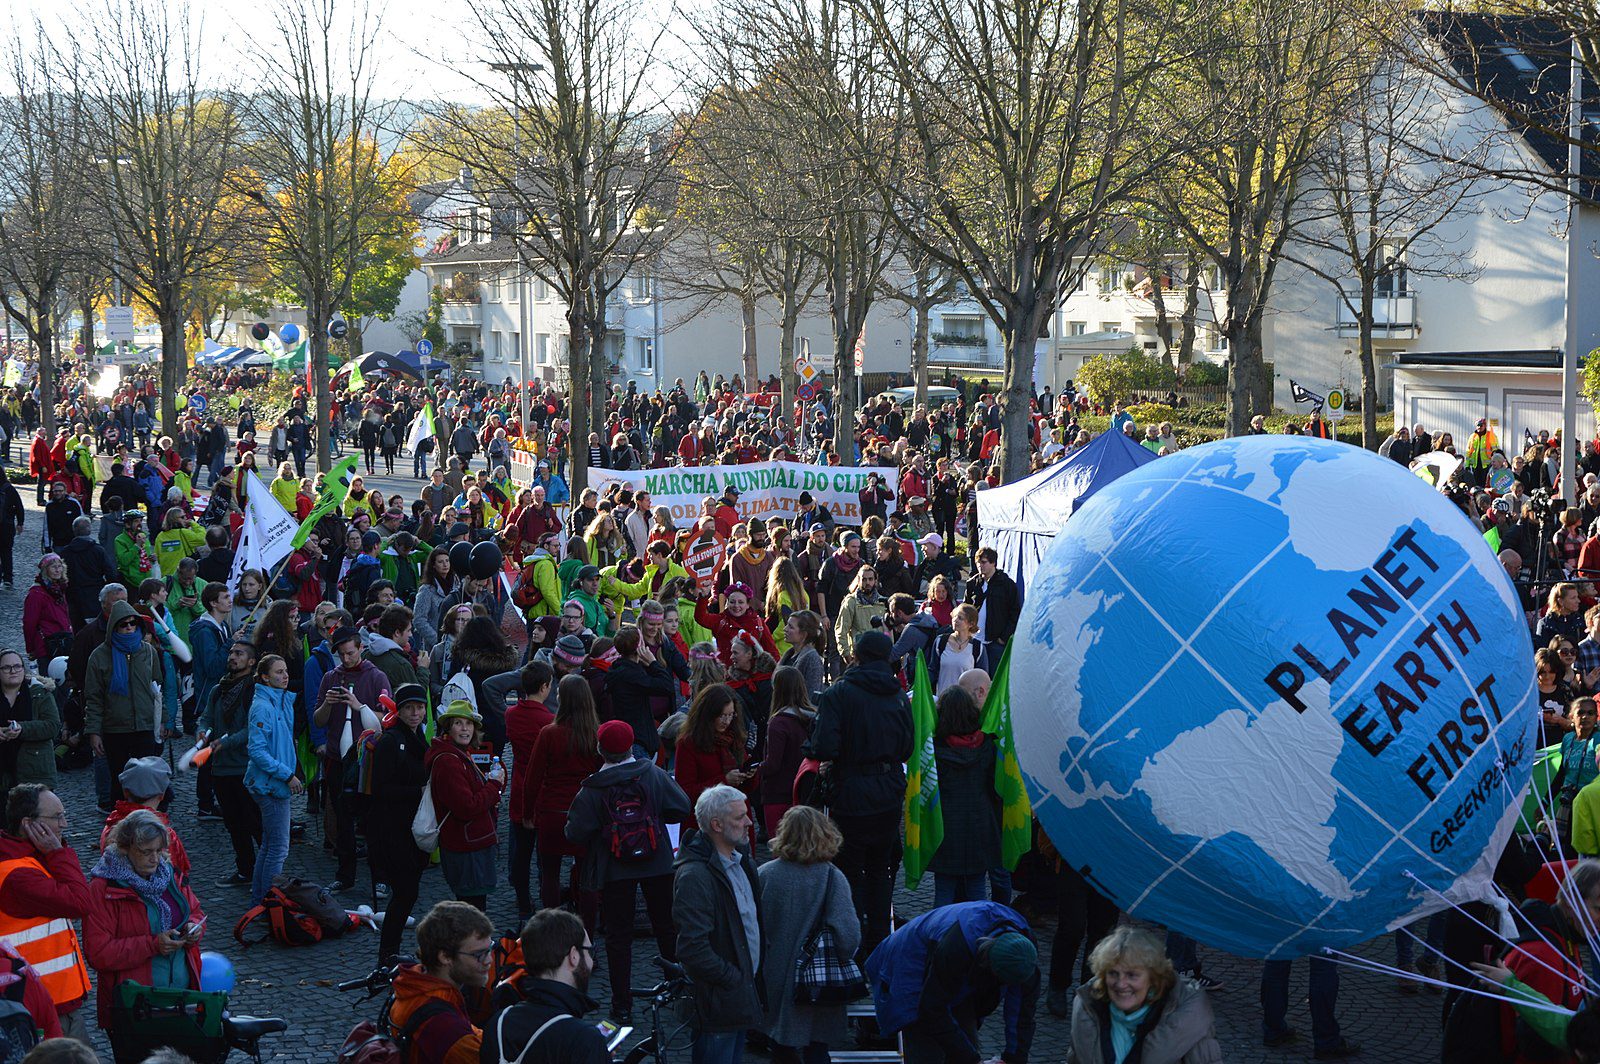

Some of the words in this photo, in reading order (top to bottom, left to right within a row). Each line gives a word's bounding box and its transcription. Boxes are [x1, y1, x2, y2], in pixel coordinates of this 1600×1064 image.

[645, 472, 719, 495] MARCHA
[723, 467, 799, 492] MUNDIAL
[802, 470, 829, 492] DO
[685, 554, 701, 567] KOHLE
[1264, 527, 1439, 714] PLANET
[1341, 600, 1482, 757] EARTH
[1407, 674, 1504, 802] FIRST
[1430, 726, 1527, 855] GREENPEACE
